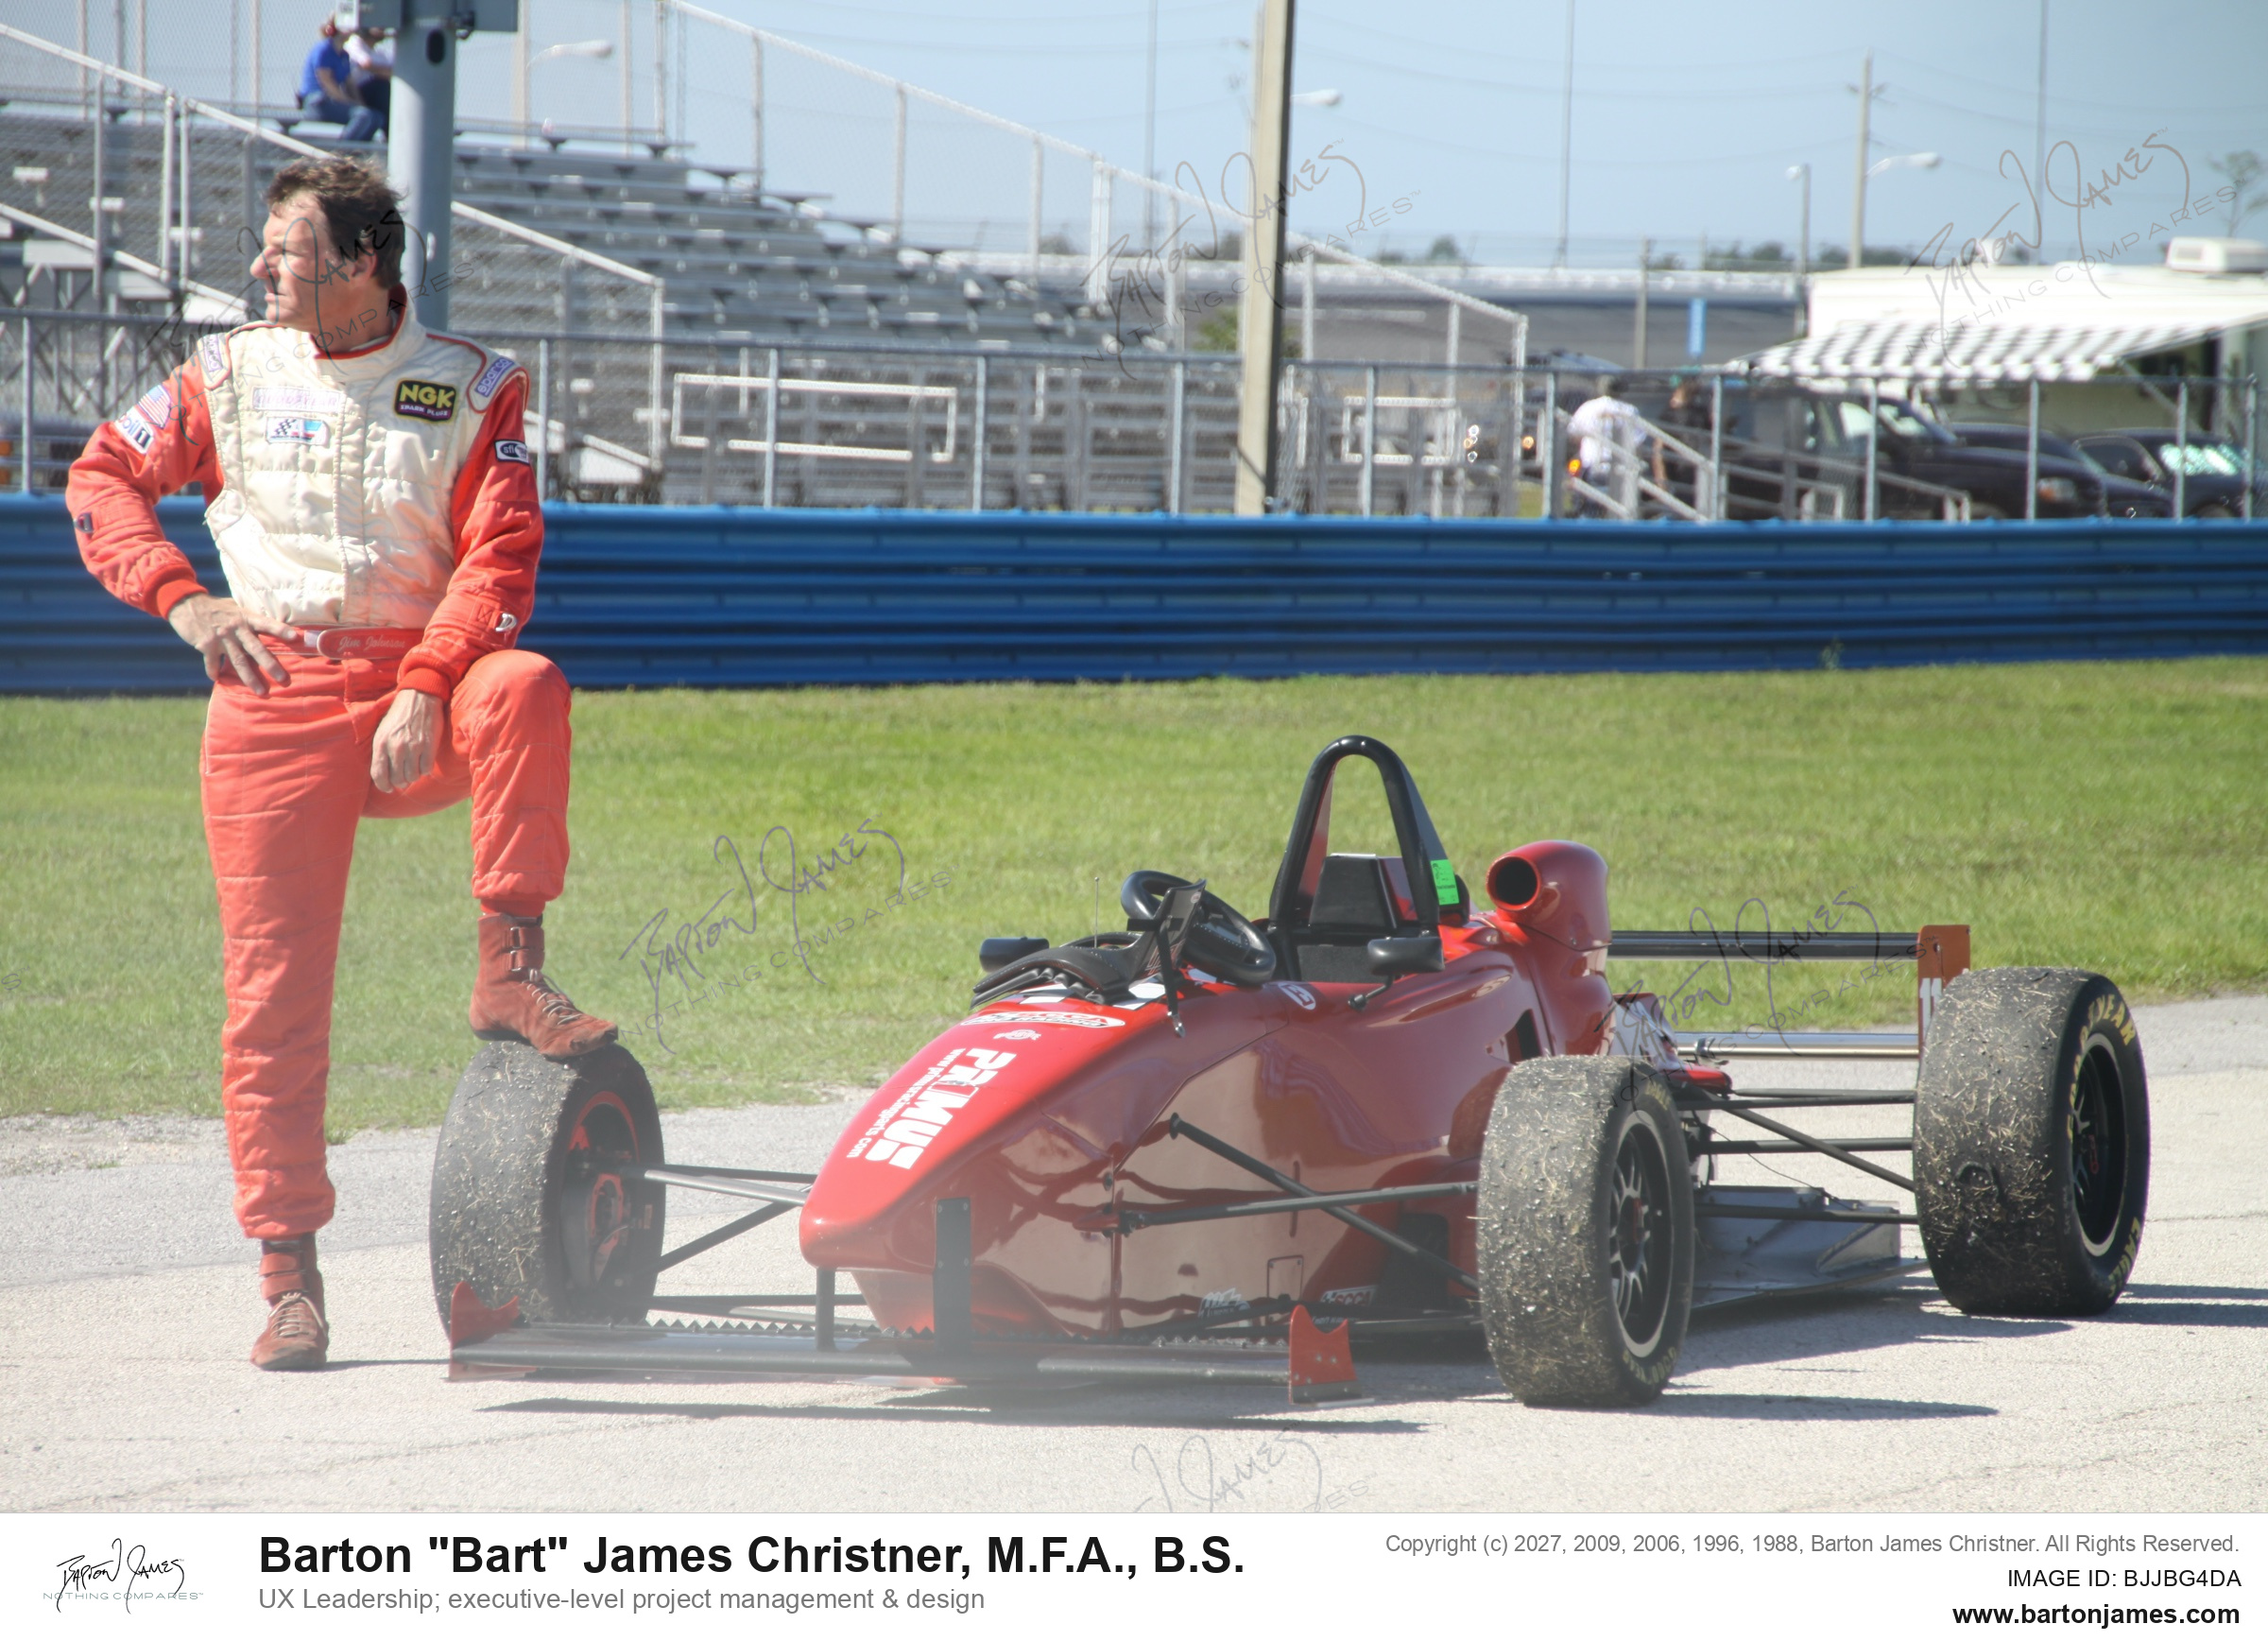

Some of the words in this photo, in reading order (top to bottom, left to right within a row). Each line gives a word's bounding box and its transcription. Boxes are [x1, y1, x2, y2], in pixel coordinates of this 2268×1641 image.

[476, 357, 512, 395] sparco
[399, 384, 456, 408] NGK
[427, 408, 448, 417] PLUGS
[338, 636, 361, 652] Jim
[864, 1047, 1018, 1170] PRIMUS
